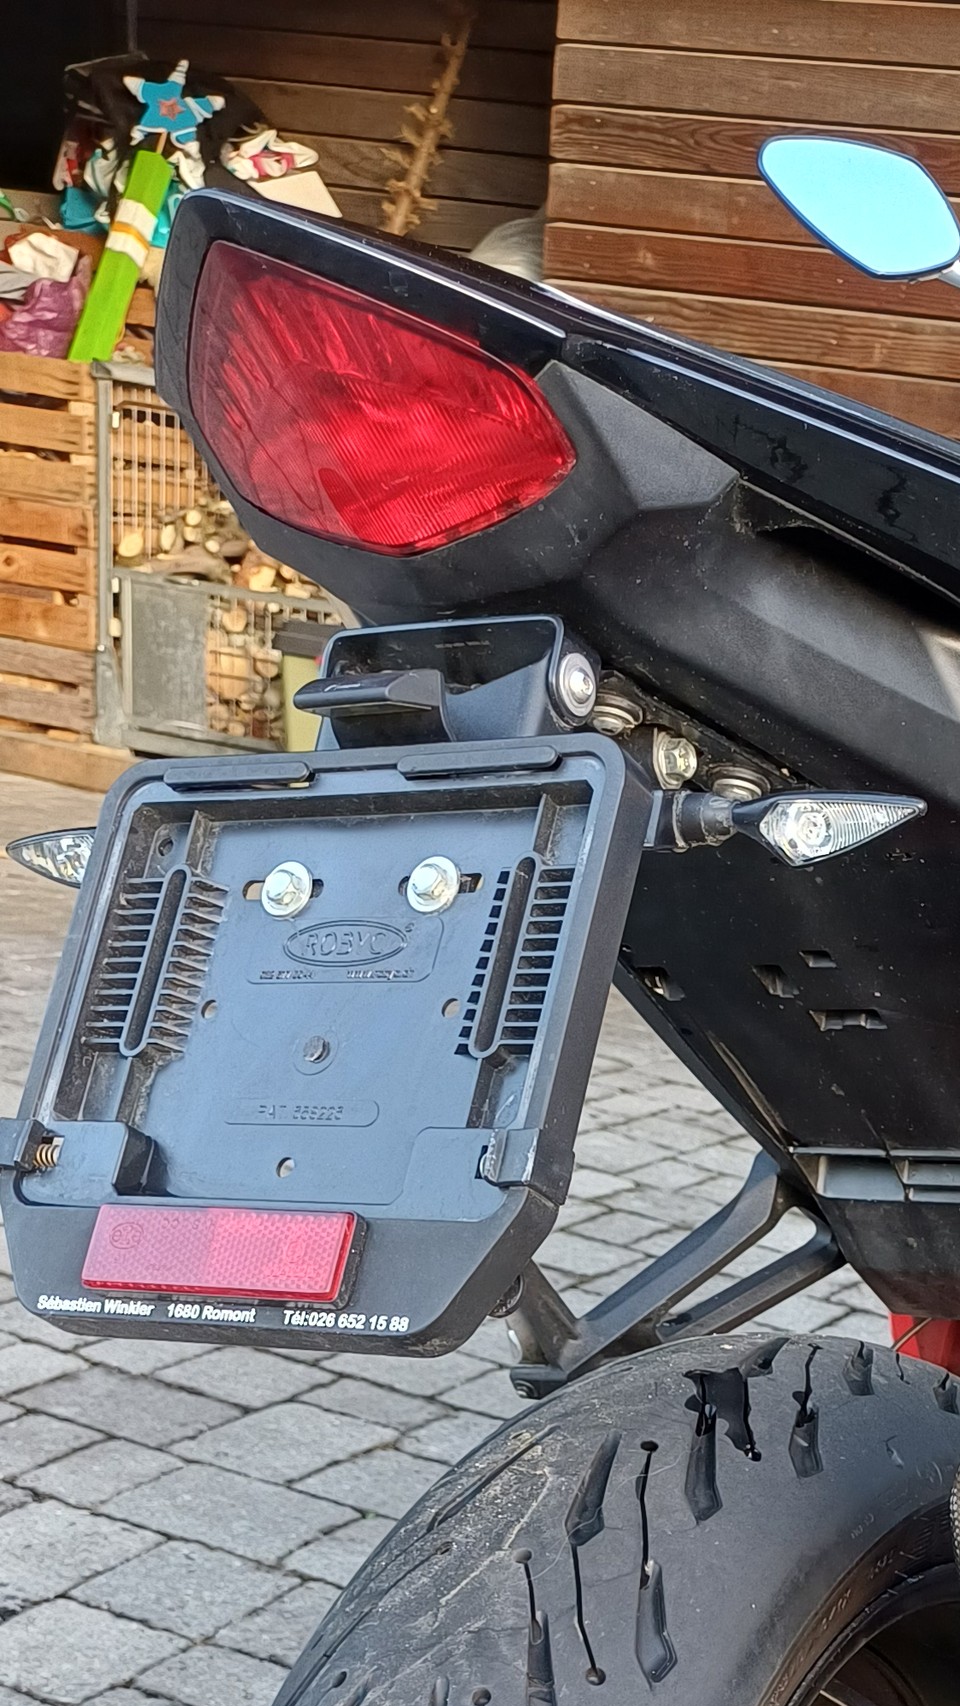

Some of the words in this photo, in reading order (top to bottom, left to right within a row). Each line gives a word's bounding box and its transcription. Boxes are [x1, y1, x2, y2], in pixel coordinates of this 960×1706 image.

[37, 1295, 102, 1313] Sébastien
[104, 1299, 155, 1316] Winkler
[167, 1303, 200, 1319] 1680
[201, 1305, 256, 1323] Romont
[337, 1313, 366, 1330] 652
[369, 1315, 388, 1331] 15
[388, 1316, 409, 1332] 88
